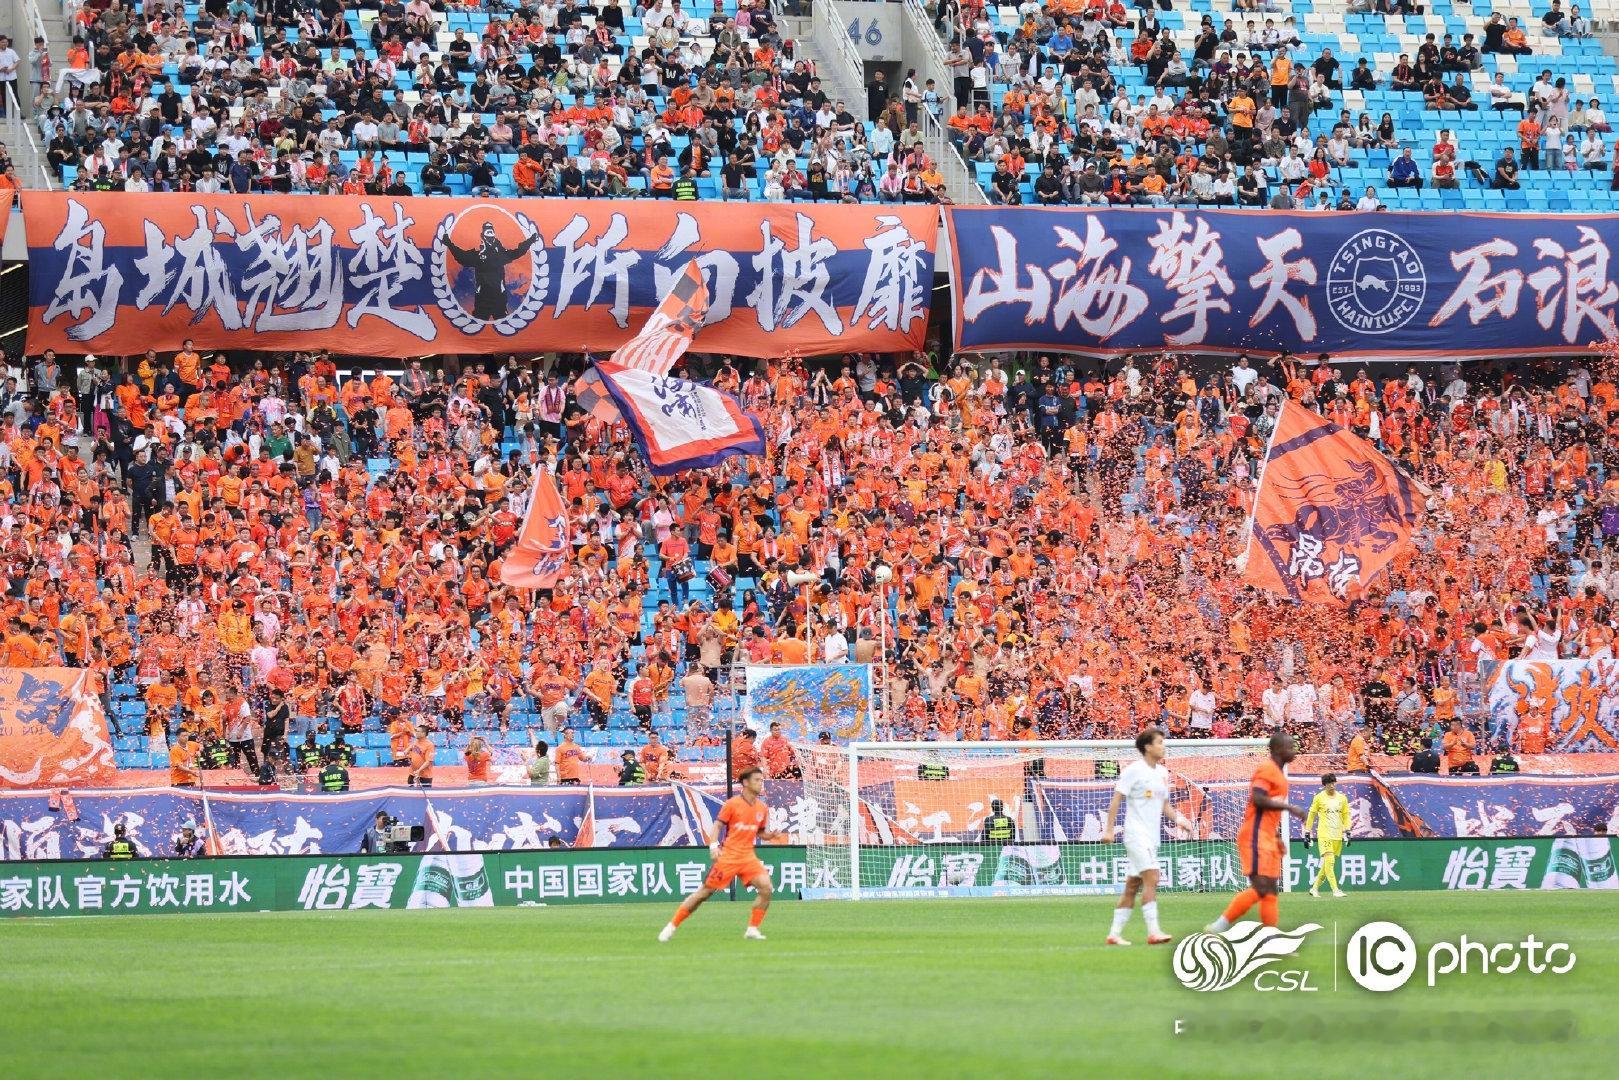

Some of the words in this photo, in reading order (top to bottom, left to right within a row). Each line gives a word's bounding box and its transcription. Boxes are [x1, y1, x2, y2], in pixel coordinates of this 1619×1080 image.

[847, 16, 882, 46] 46
[1333, 235, 1420, 275] TSINGTAO
[963, 211, 1319, 346] 山海擎天
[1332, 286, 1352, 294] EST.
[1400, 284, 1421, 292] 1993
[298, 863, 403, 910] 怡寶
[505, 859, 842, 899] 中国国家队官用水
[1081, 852, 1400, 887] 中国国家队用水
[1442, 845, 1536, 890] 怡寶
[0, 871, 252, 910] 家队官方饮用水
